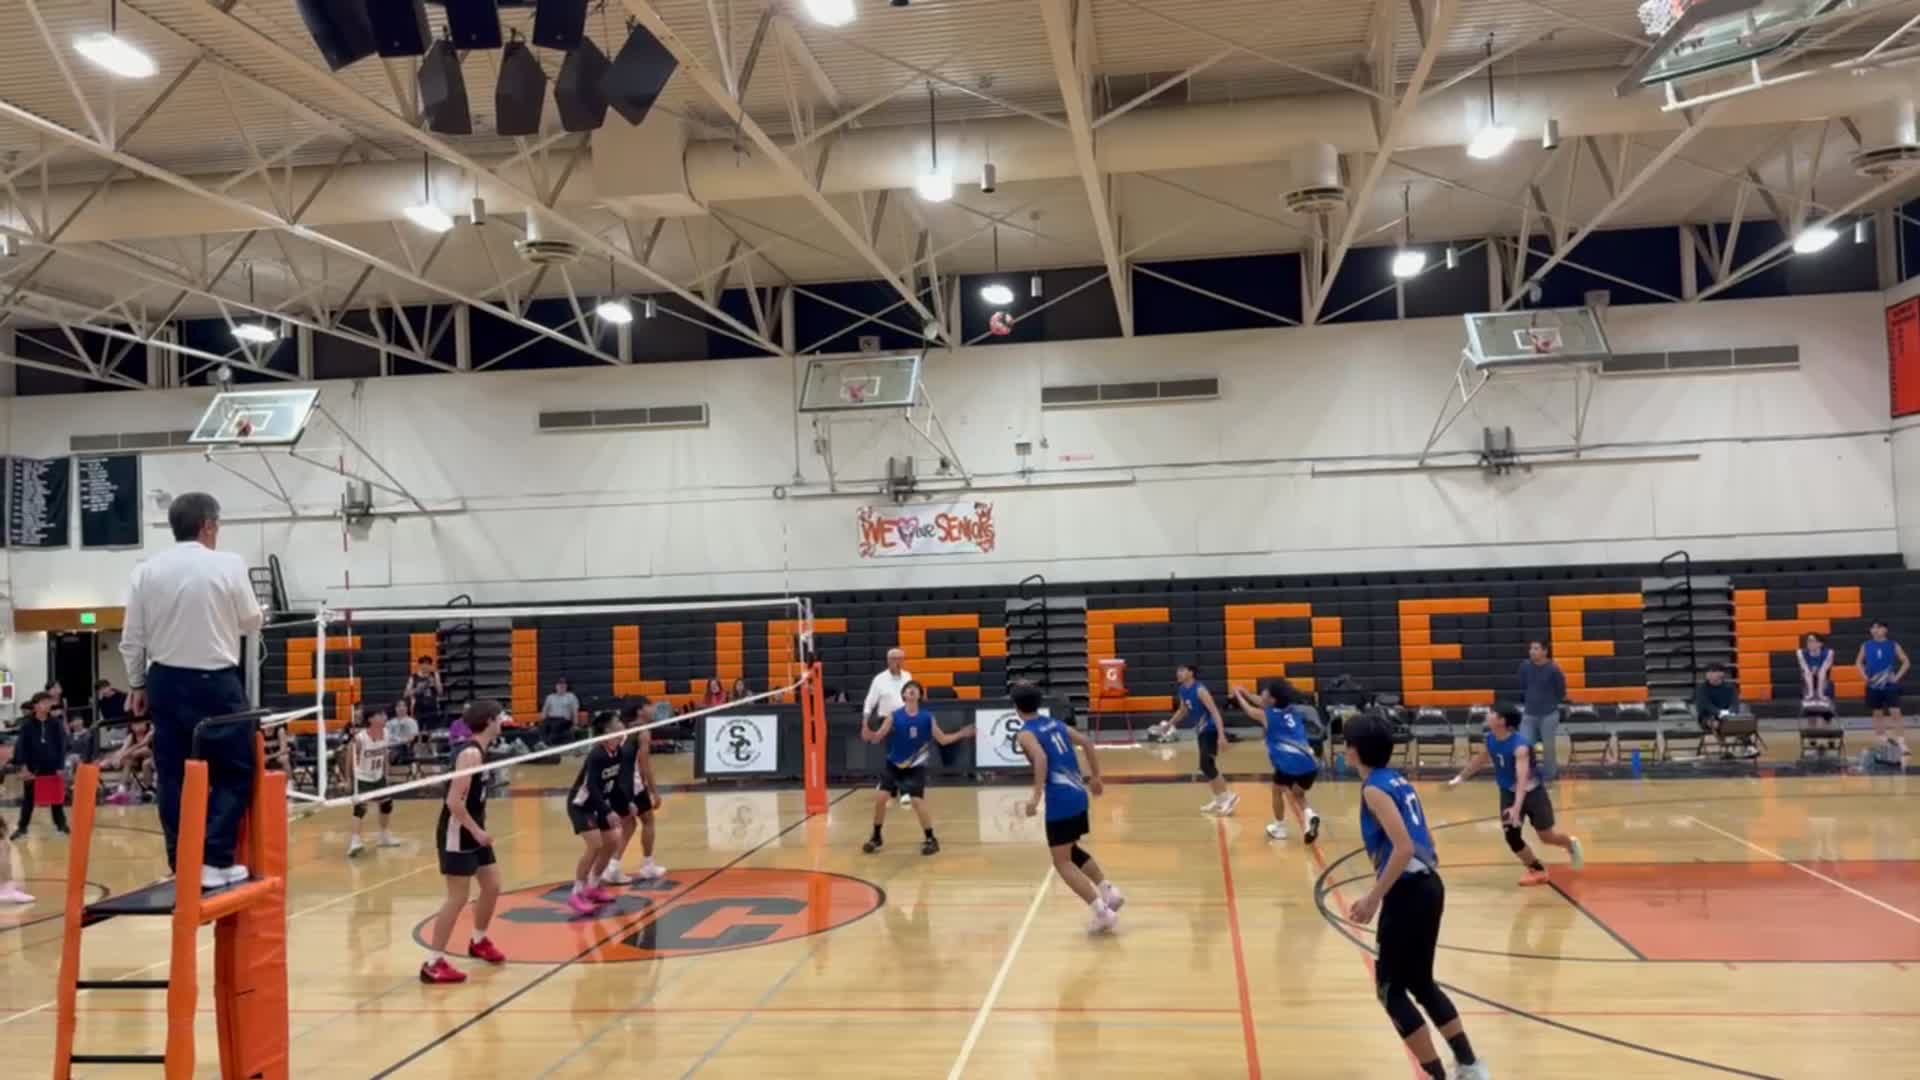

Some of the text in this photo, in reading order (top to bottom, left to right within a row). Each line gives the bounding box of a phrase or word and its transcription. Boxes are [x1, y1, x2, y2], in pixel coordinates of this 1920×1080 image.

[861, 517, 896, 548] WE
[935, 513, 994, 542] SENIORS
[1086, 586, 1867, 712] CREEK
[1283, 713, 1296, 729] 3
[729, 725, 751, 762] SC
[1051, 731, 1069, 755] 11
